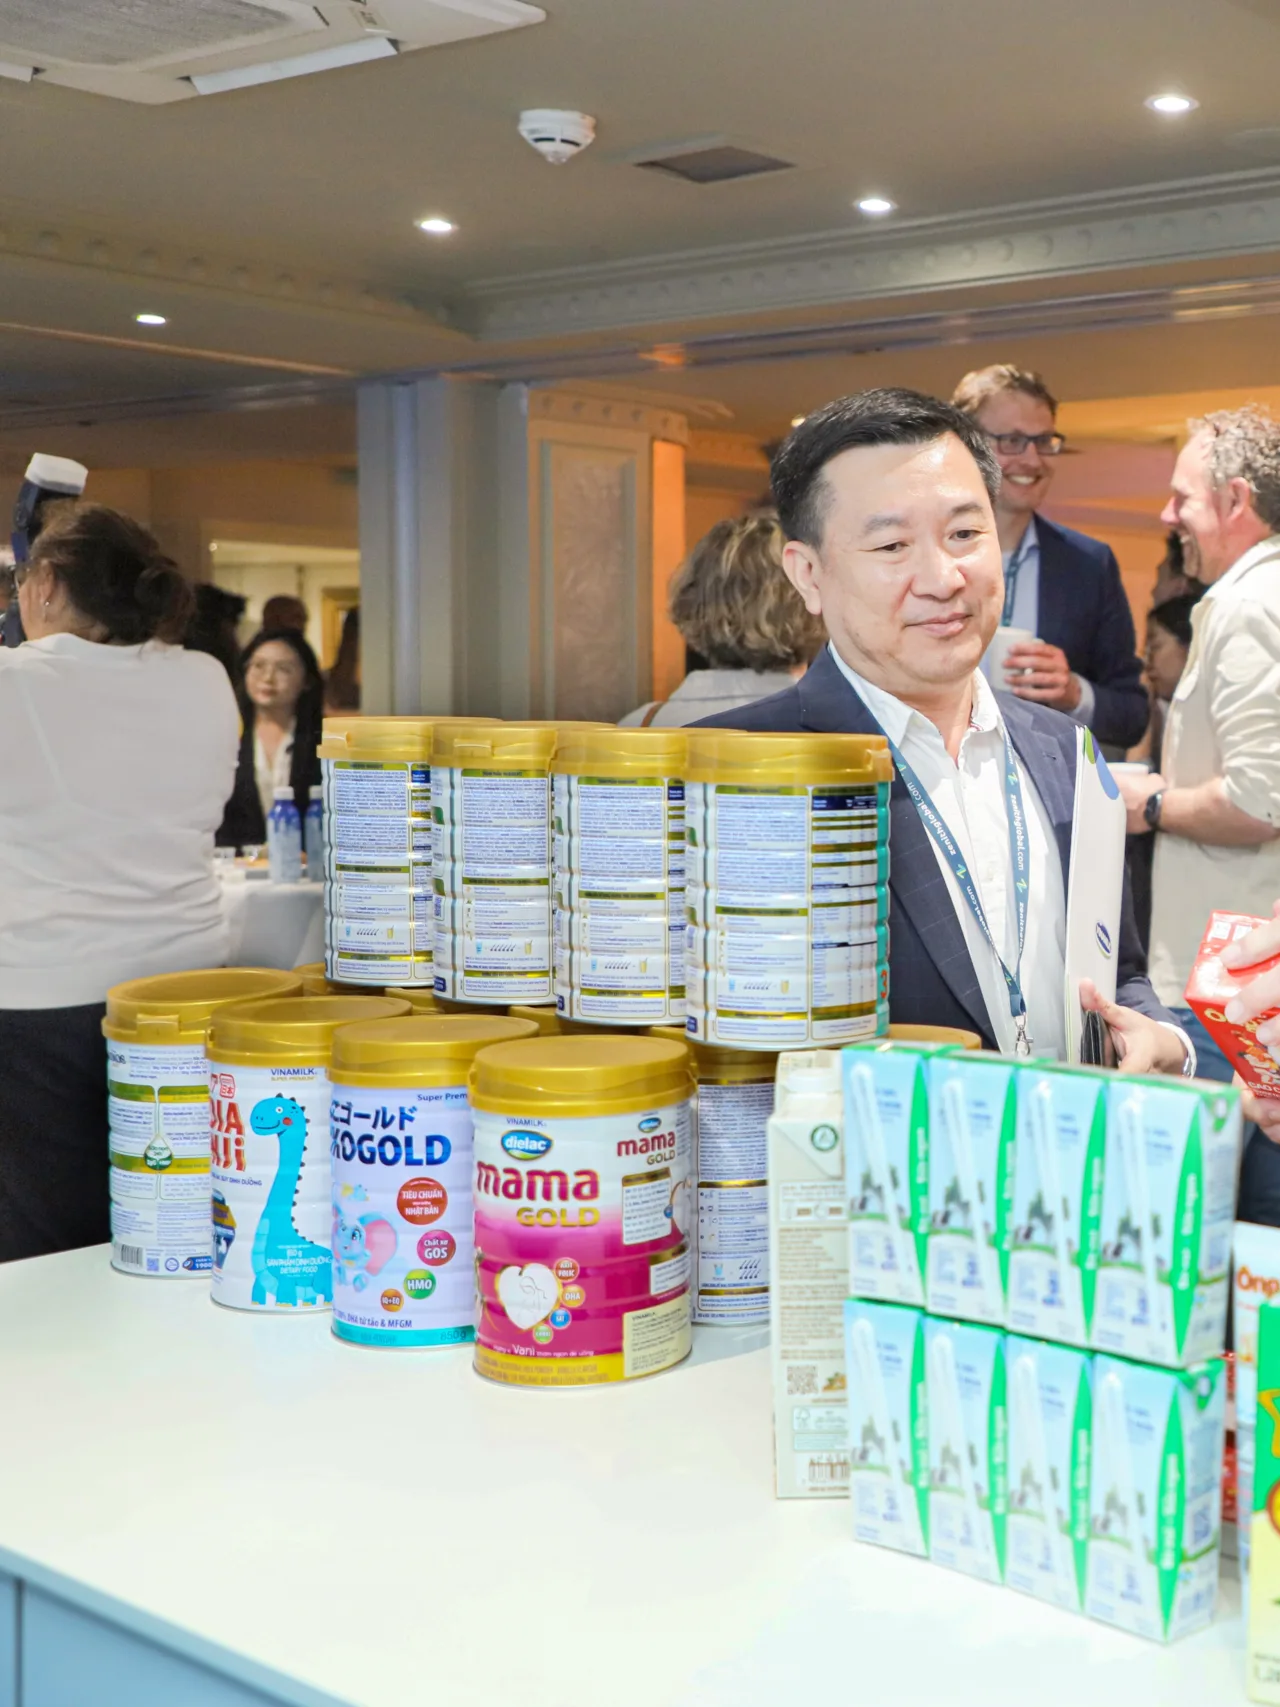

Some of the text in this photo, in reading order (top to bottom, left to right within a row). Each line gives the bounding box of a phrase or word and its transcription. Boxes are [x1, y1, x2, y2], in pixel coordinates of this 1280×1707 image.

[907, 781, 957, 856] zenithglobal.com
[1010, 794, 1026, 871] zenithglobal.com
[271, 1068, 315, 1076] VINAMILK
[417, 1094, 443, 1102] Super
[506, 1117, 544, 1127] VINAMILK
[505, 1136, 547, 1151] dielac
[616, 1131, 676, 1157] mama
[646, 1149, 676, 1166] GOLD
[476, 1161, 600, 1202] mama
[516, 1207, 600, 1227] GOLD
[424, 1248, 448, 1259] GOS
[407, 1279, 433, 1290] HMO
[565, 1292, 581, 1300] DHA
[347, 1313, 359, 1324] DHA
[387, 1319, 412, 1328] MFGM
[511, 1344, 535, 1356] Vani
